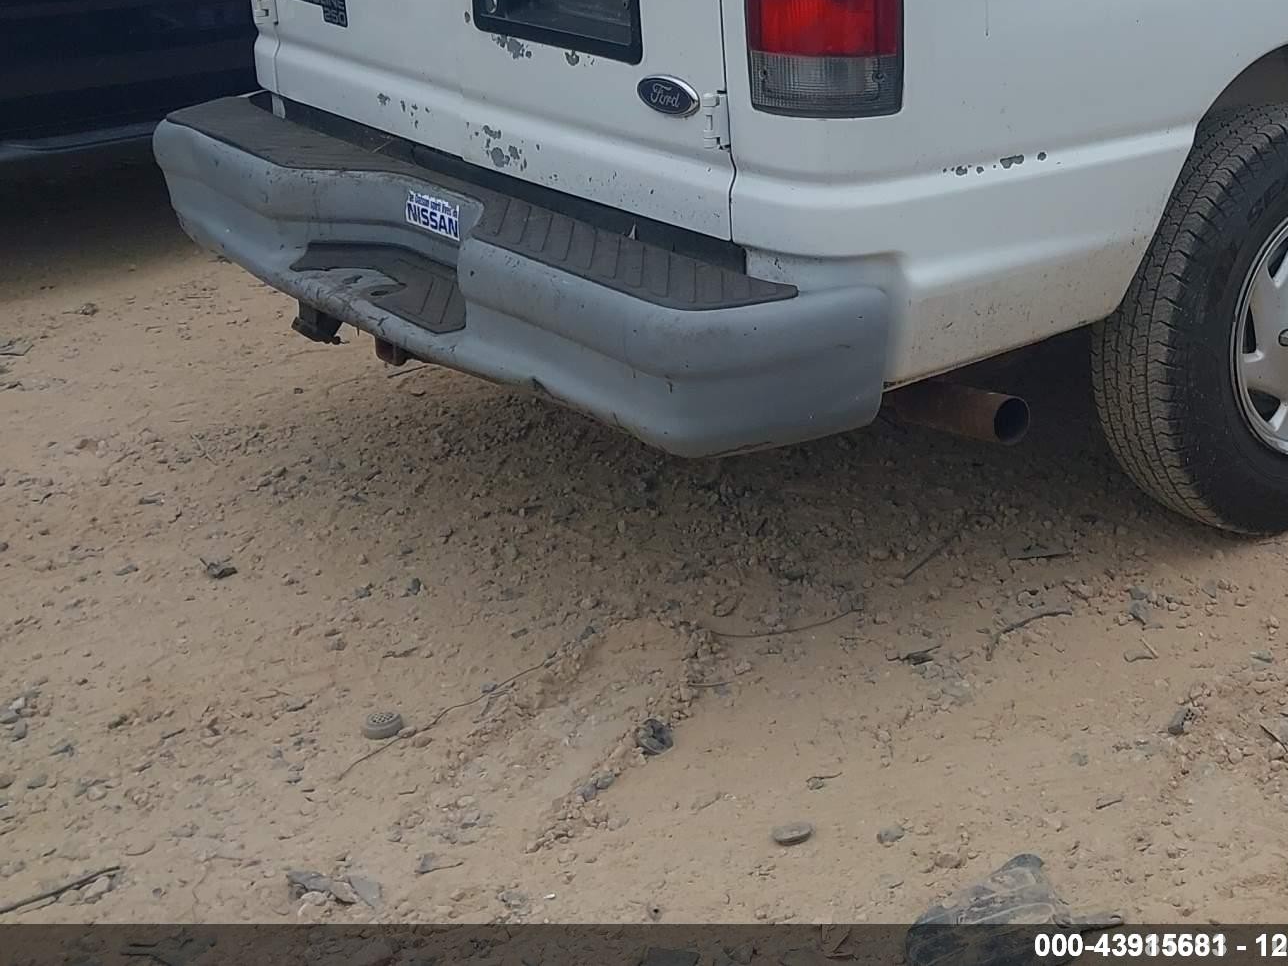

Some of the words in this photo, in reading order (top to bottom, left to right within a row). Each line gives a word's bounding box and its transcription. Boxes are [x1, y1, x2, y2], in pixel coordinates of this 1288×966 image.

[324, 7, 347, 26] 250
[650, 83, 680, 108] Ford
[406, 203, 459, 238] NISSAN
